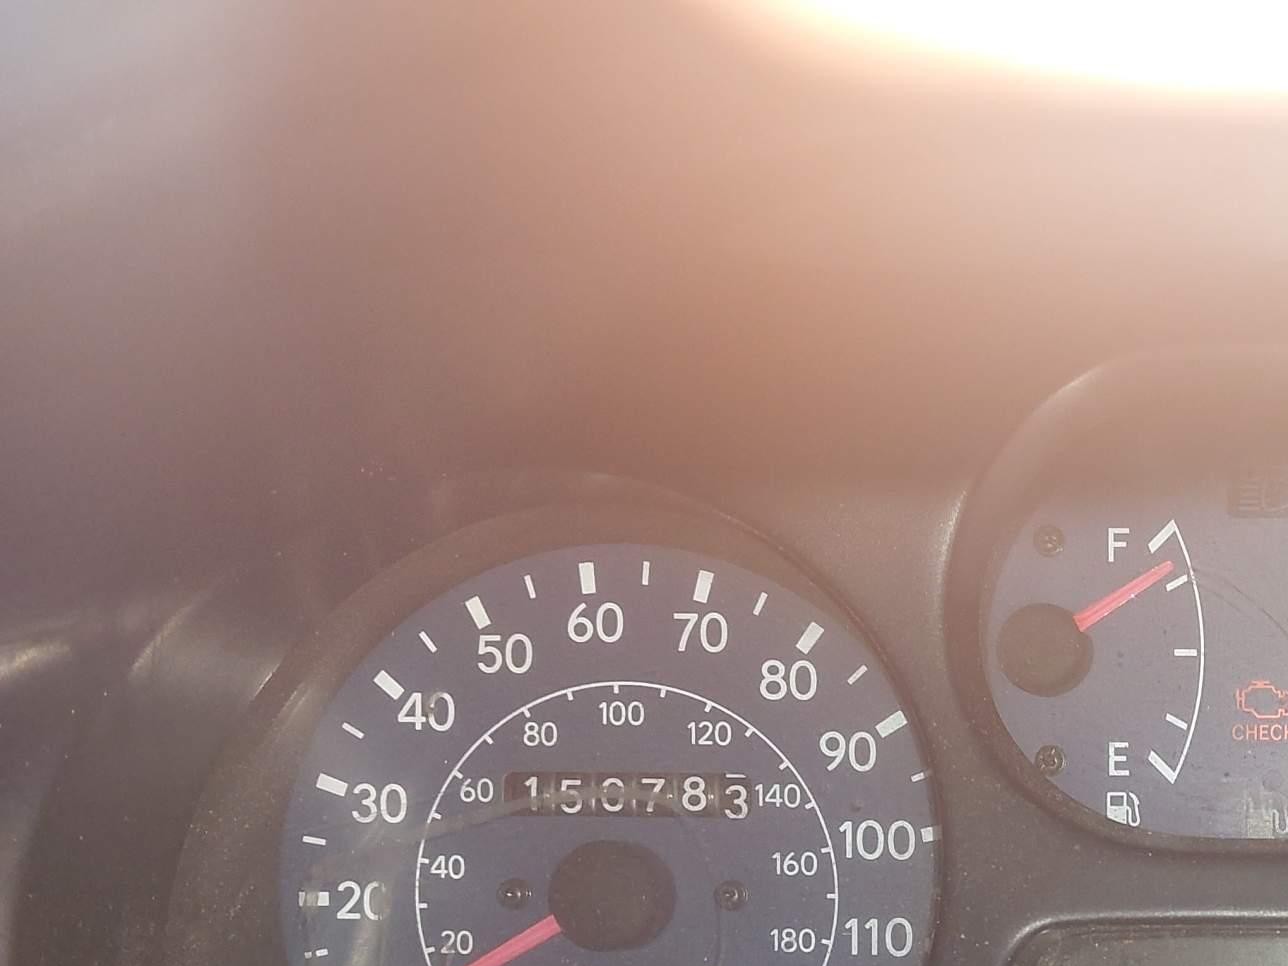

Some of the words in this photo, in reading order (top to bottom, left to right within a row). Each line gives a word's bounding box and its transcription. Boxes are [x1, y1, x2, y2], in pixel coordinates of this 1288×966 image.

[1109, 528, 1129, 562] F
[568, 603, 623, 642] 60
[674, 613, 727, 652] 70
[478, 634, 532, 673] 50
[760, 660, 817, 700] 80
[398, 692, 455, 731] 40
[599, 701, 644, 725] 100
[524, 722, 557, 746] 80
[688, 722, 731, 745] 120
[820, 731, 876, 771] 90
[1109, 742, 1129, 775] E
[352, 784, 407, 823] 30
[460, 779, 493, 802] 60
[755, 784, 800, 807] 140
[839, 820, 915, 860] 100
[431, 855, 465, 879] 40
[773, 852, 817, 875] 160
[440, 931, 473, 955] 20
[771, 929, 815, 952] 180
[845, 918, 912, 957] 110
